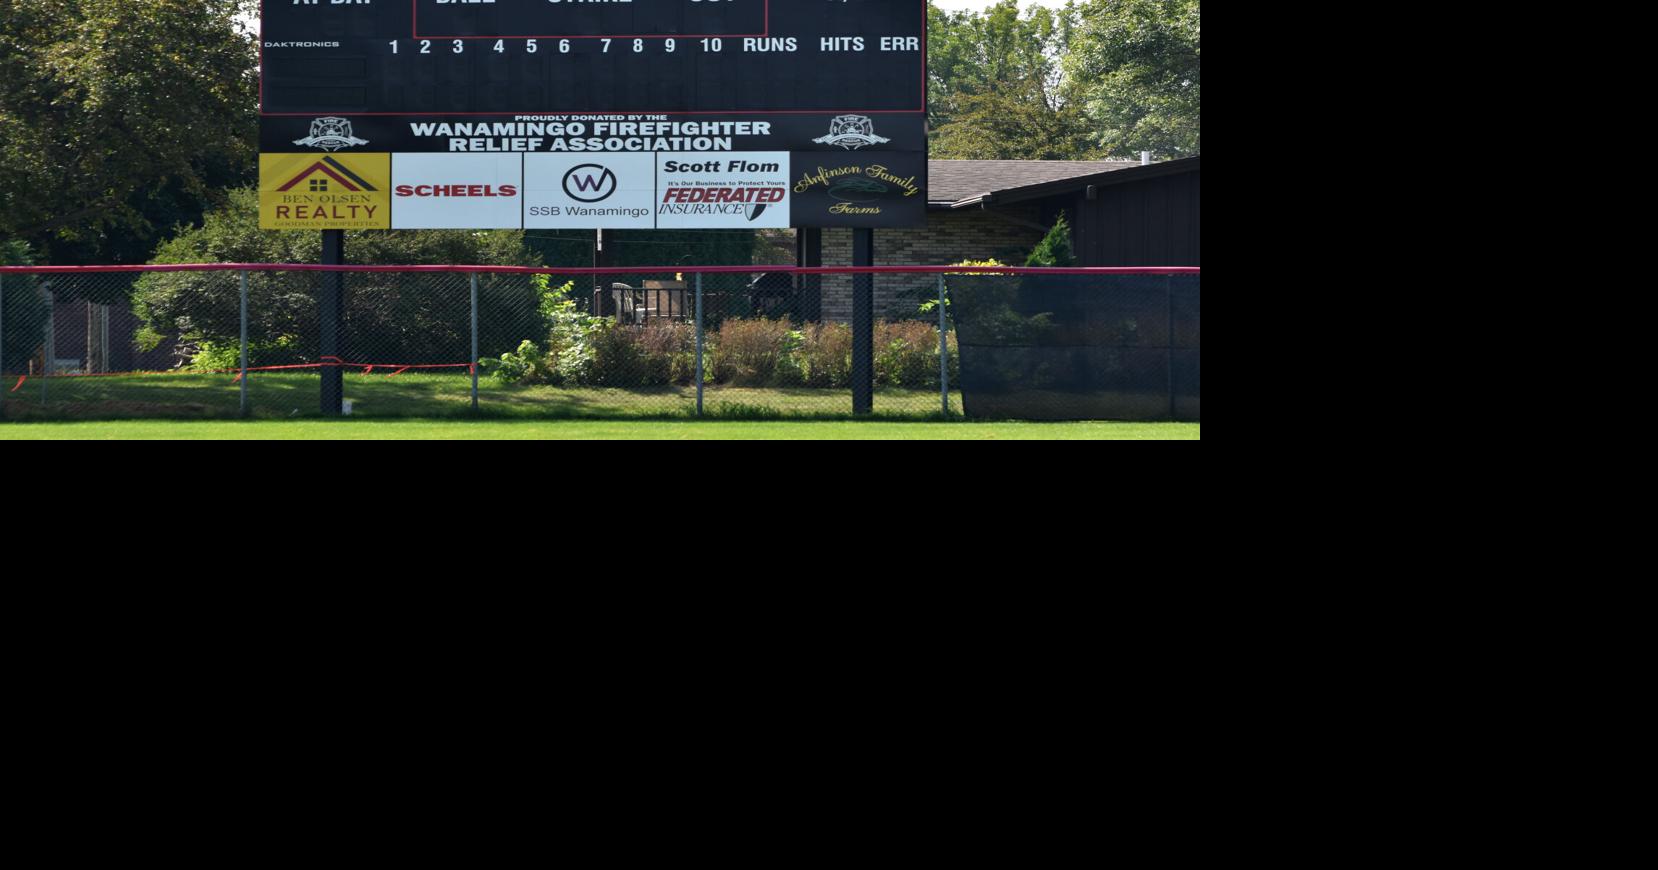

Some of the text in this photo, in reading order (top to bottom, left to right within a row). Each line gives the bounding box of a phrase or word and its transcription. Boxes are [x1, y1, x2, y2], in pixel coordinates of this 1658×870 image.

[389, 37, 919, 54] 1 2 3 4 5 6 7 8 9 10 RUNS HITS ERR
[410, 121, 771, 137] WANAMINGO FIREFIGHTER
[449, 137, 732, 152] RELIEF ASSOCIATION
[664, 160, 780, 173] Scott Flom
[793, 164, 919, 197] Anfinson Family
[395, 184, 518, 197] SCHEELS
[663, 187, 786, 203] FEDERATED
[283, 194, 371, 203] BEN OLSEN
[276, 205, 378, 219] REALTY
[529, 206, 649, 218] SSB Wanamingo
[658, 203, 745, 215] INSURANCE
[828, 202, 881, 214] Farms
